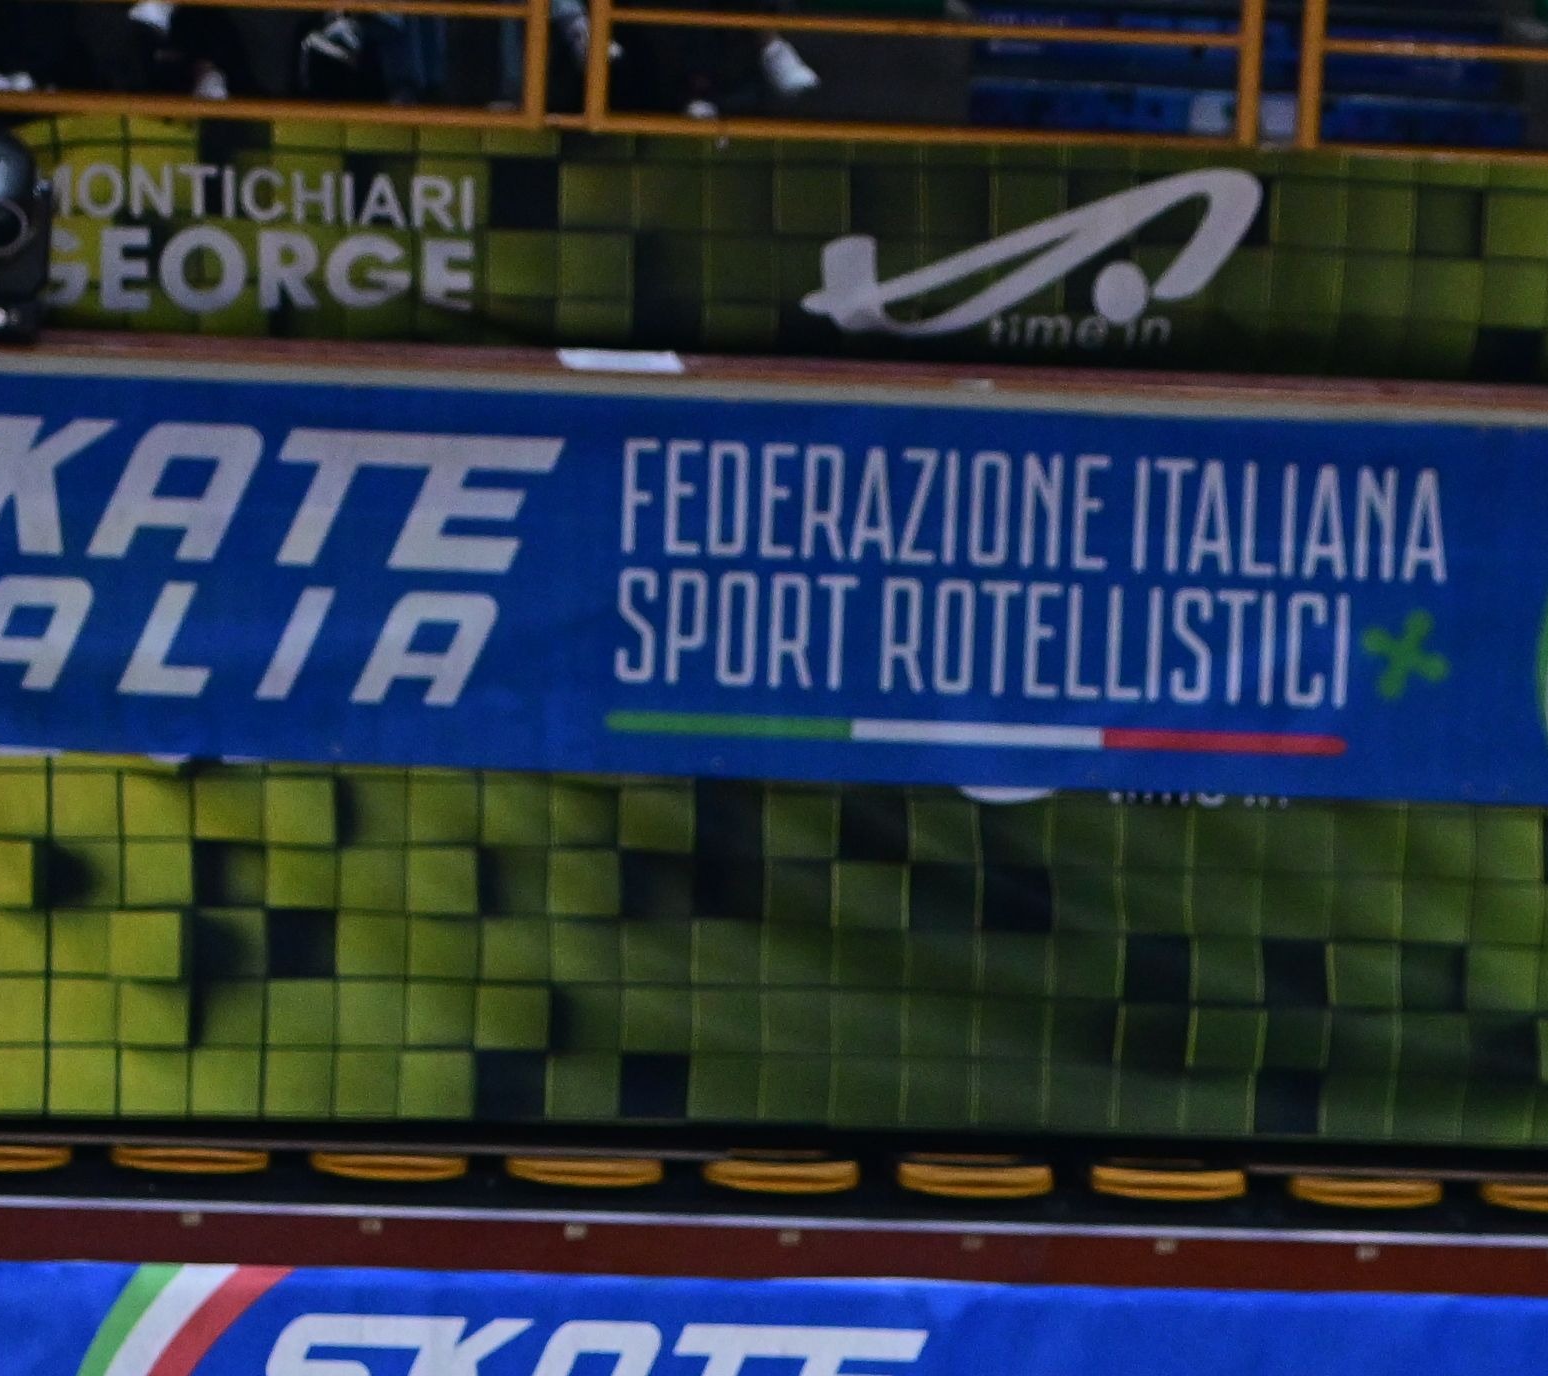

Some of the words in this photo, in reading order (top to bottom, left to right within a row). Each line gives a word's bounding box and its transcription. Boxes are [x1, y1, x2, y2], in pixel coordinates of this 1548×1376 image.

[620, 437, 1111, 572] FEDERAZIONE
[1132, 456, 1447, 582] ITALIANA
[614, 566, 858, 691] SPORT
[880, 576, 1351, 709] ROTELLISTICI
